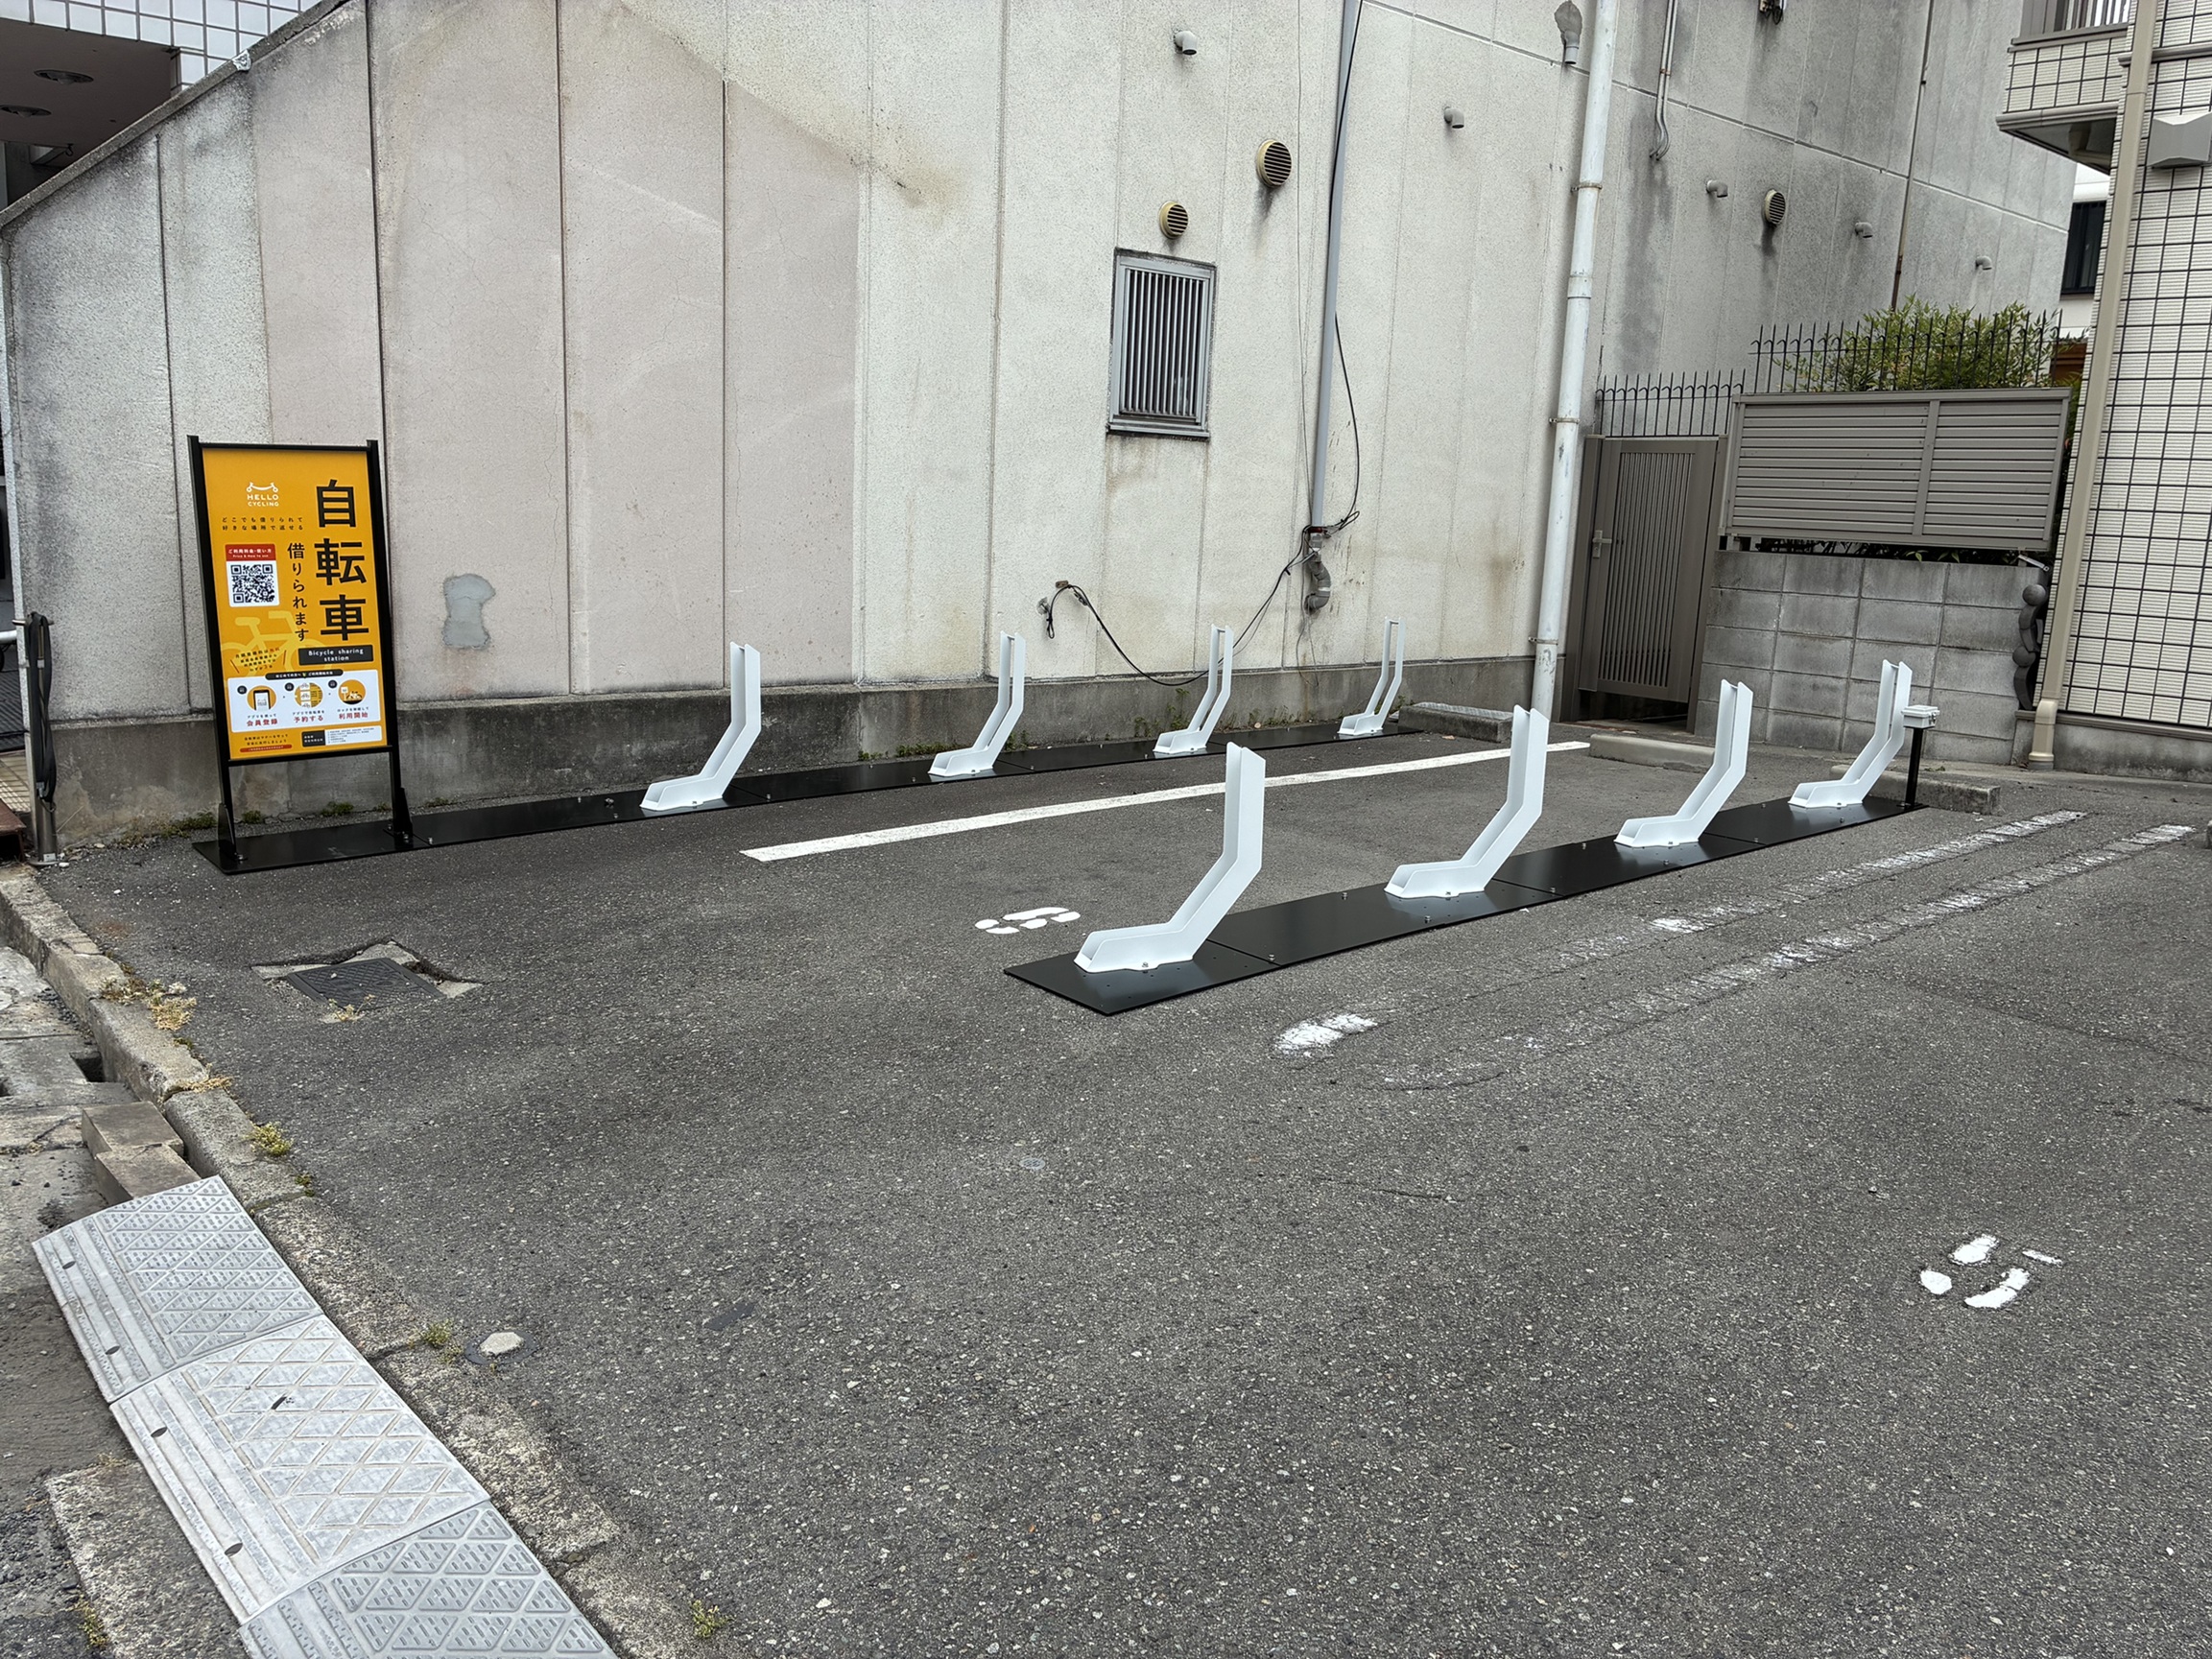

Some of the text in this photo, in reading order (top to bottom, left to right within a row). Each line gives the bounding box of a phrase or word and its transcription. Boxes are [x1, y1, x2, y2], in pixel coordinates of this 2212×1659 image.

[287, 542, 310, 642] 借りられます
[314, 478, 369, 641] 自転車
[294, 715, 323, 723] 予約する
